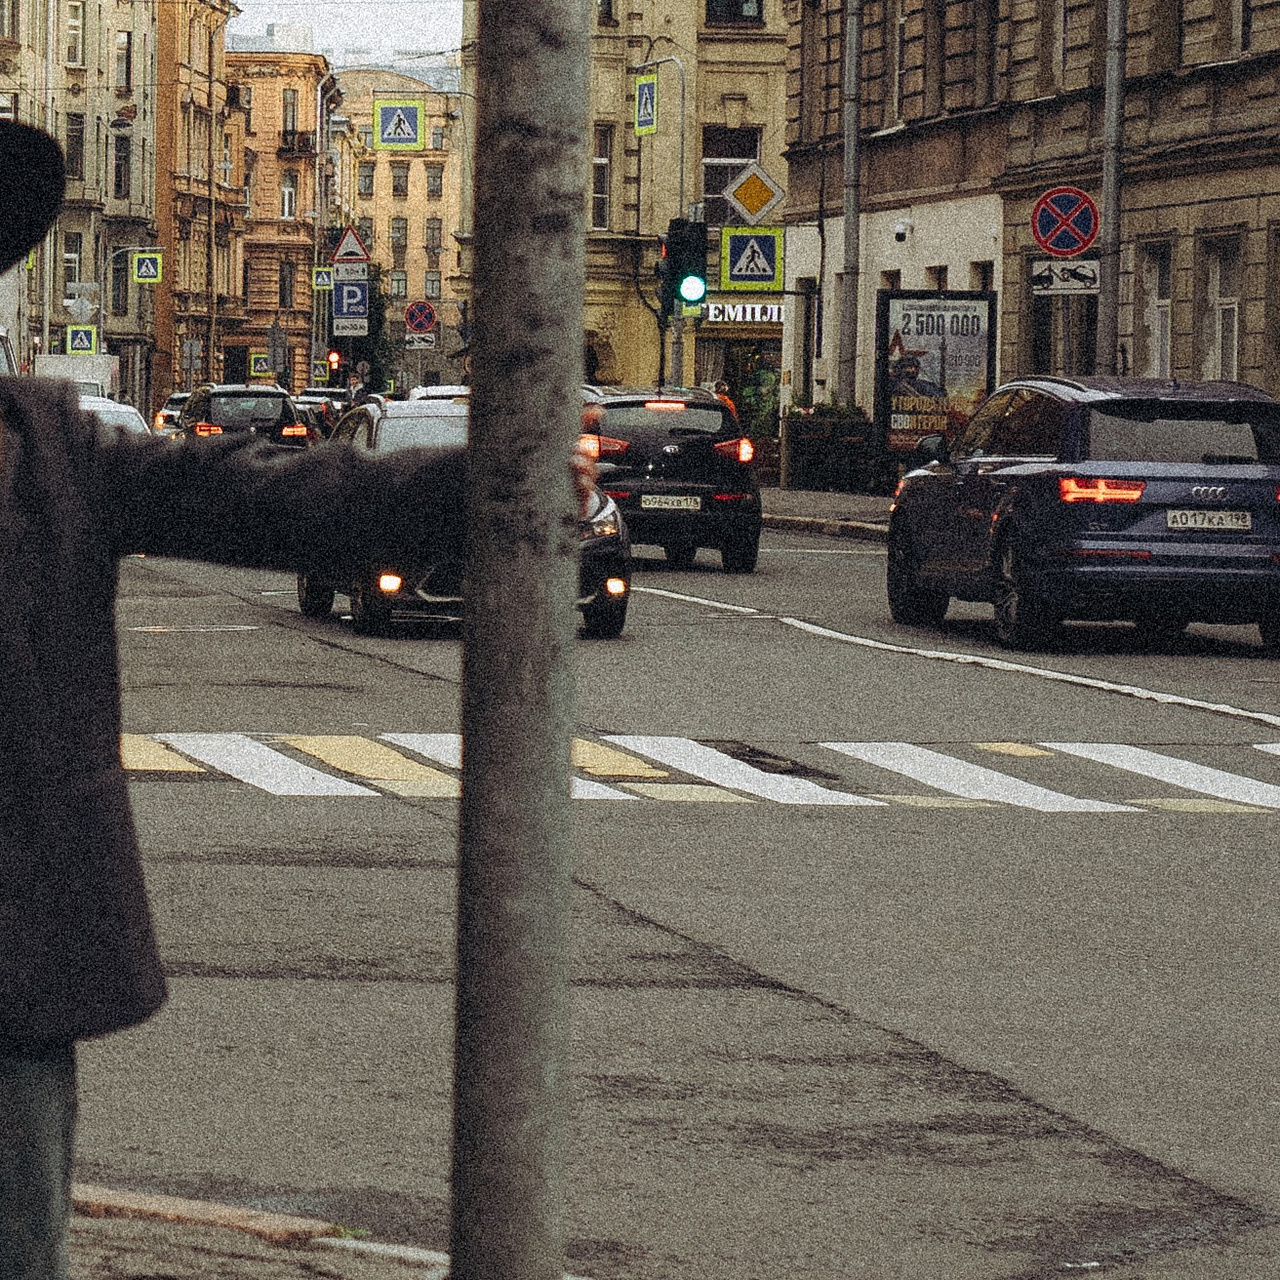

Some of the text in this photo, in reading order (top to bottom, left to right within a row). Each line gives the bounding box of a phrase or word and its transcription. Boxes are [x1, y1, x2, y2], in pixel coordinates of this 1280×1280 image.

[342, 285, 362, 314] P
[701, 303, 785, 322] ЕМПЛ
[901, 312, 981, 337] 2 500 000
